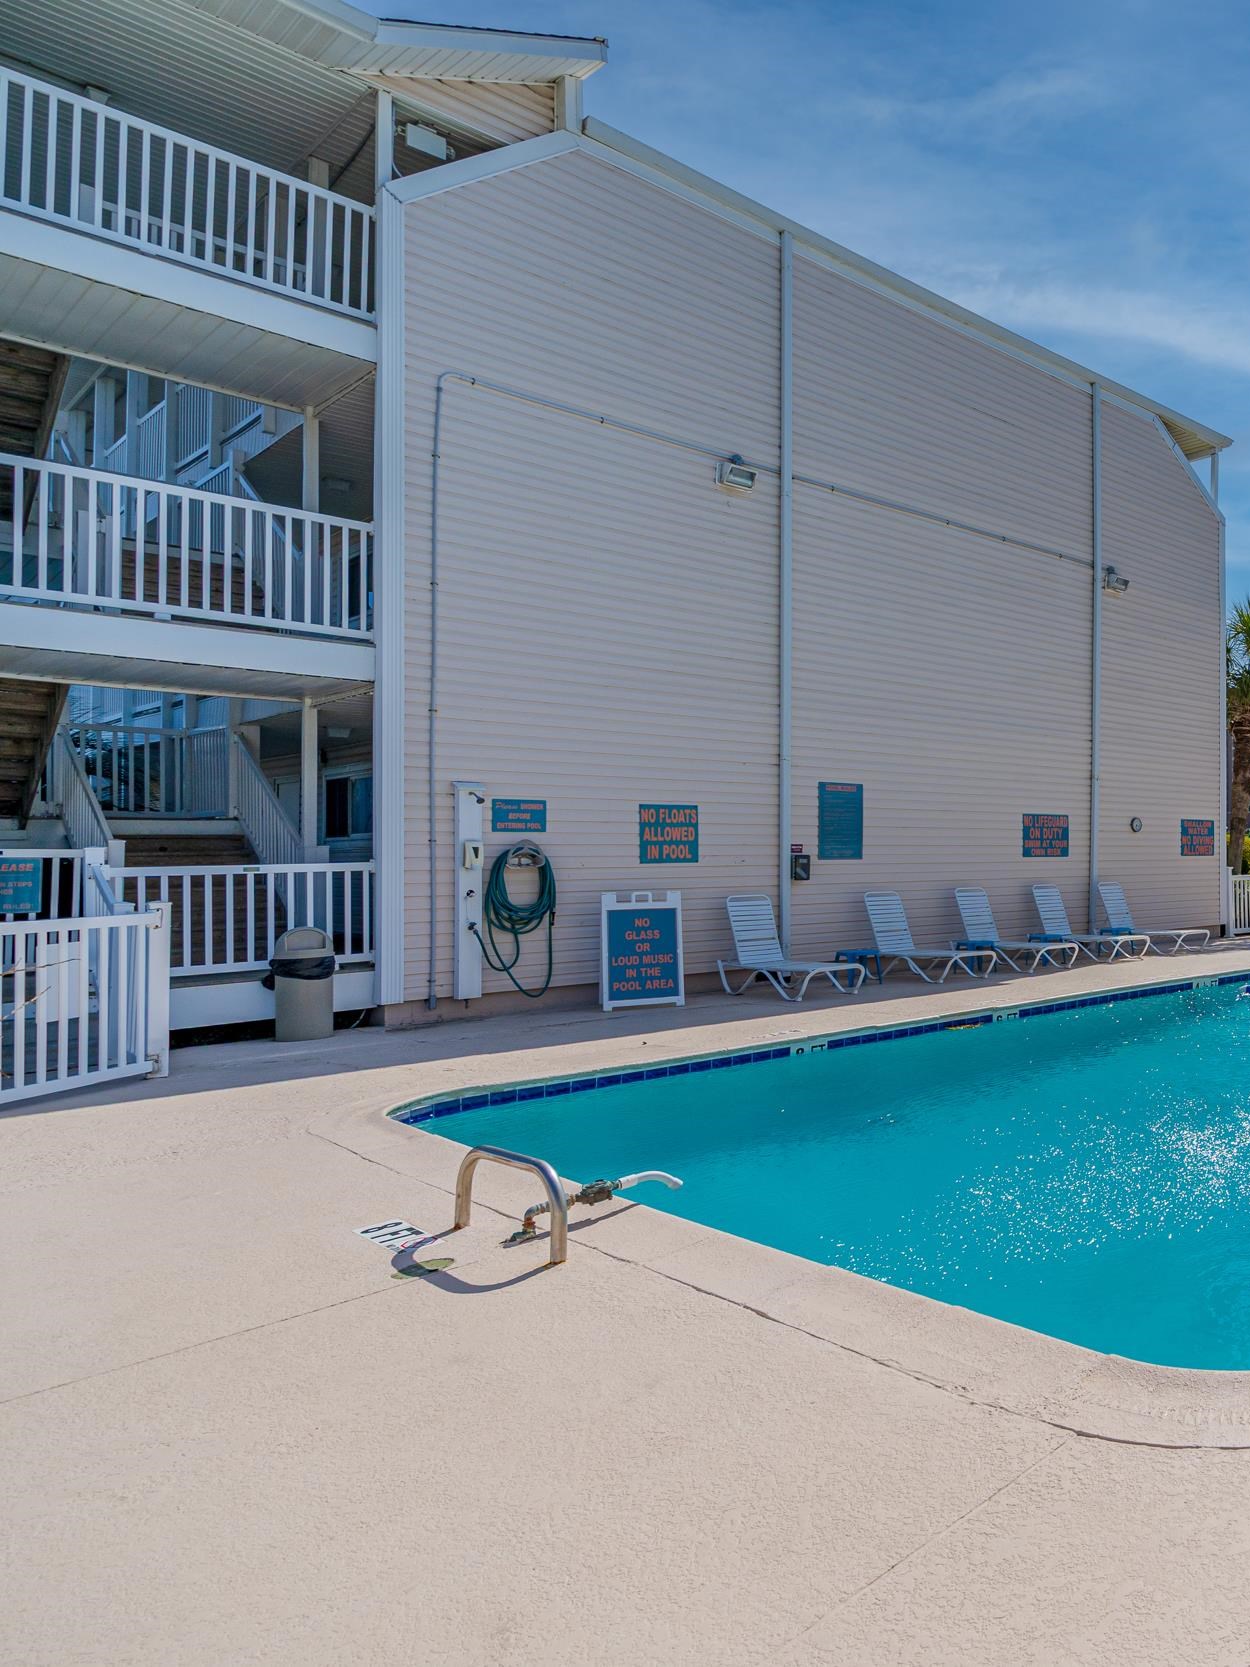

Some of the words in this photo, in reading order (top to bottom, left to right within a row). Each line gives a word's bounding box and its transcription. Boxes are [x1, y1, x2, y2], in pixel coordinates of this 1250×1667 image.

[641, 809, 657, 823] NO
[659, 808, 697, 823] FLOATS
[1023, 815, 1033, 826] NO
[1034, 815, 1068, 827] LIFEGUARD
[643, 826, 695, 841] ALLOWED
[1030, 828, 1041, 839] ON
[1043, 828, 1062, 839] DUTY
[1182, 836, 1191, 845] NO
[1193, 836, 1214, 845] DIVING
[647, 845, 659, 859] IN
[663, 845, 692, 859] POOL
[1184, 845, 1214, 855] ALLOWED
[0, 863, 34, 872] EASE
[634, 918, 650, 928] NO
[625, 930, 661, 940] GLASS
[635, 942, 651, 952] OR
[612, 955, 640, 966] LOUD
[642, 953, 674, 965] MUSIC
[625, 968, 637, 978] IN
[640, 967, 661, 977] THE
[613, 981, 642, 991] POOL
[645, 979, 674, 990] AREA
[360, 1221, 403, 1234] 8
[370, 1226, 424, 1243] FT
